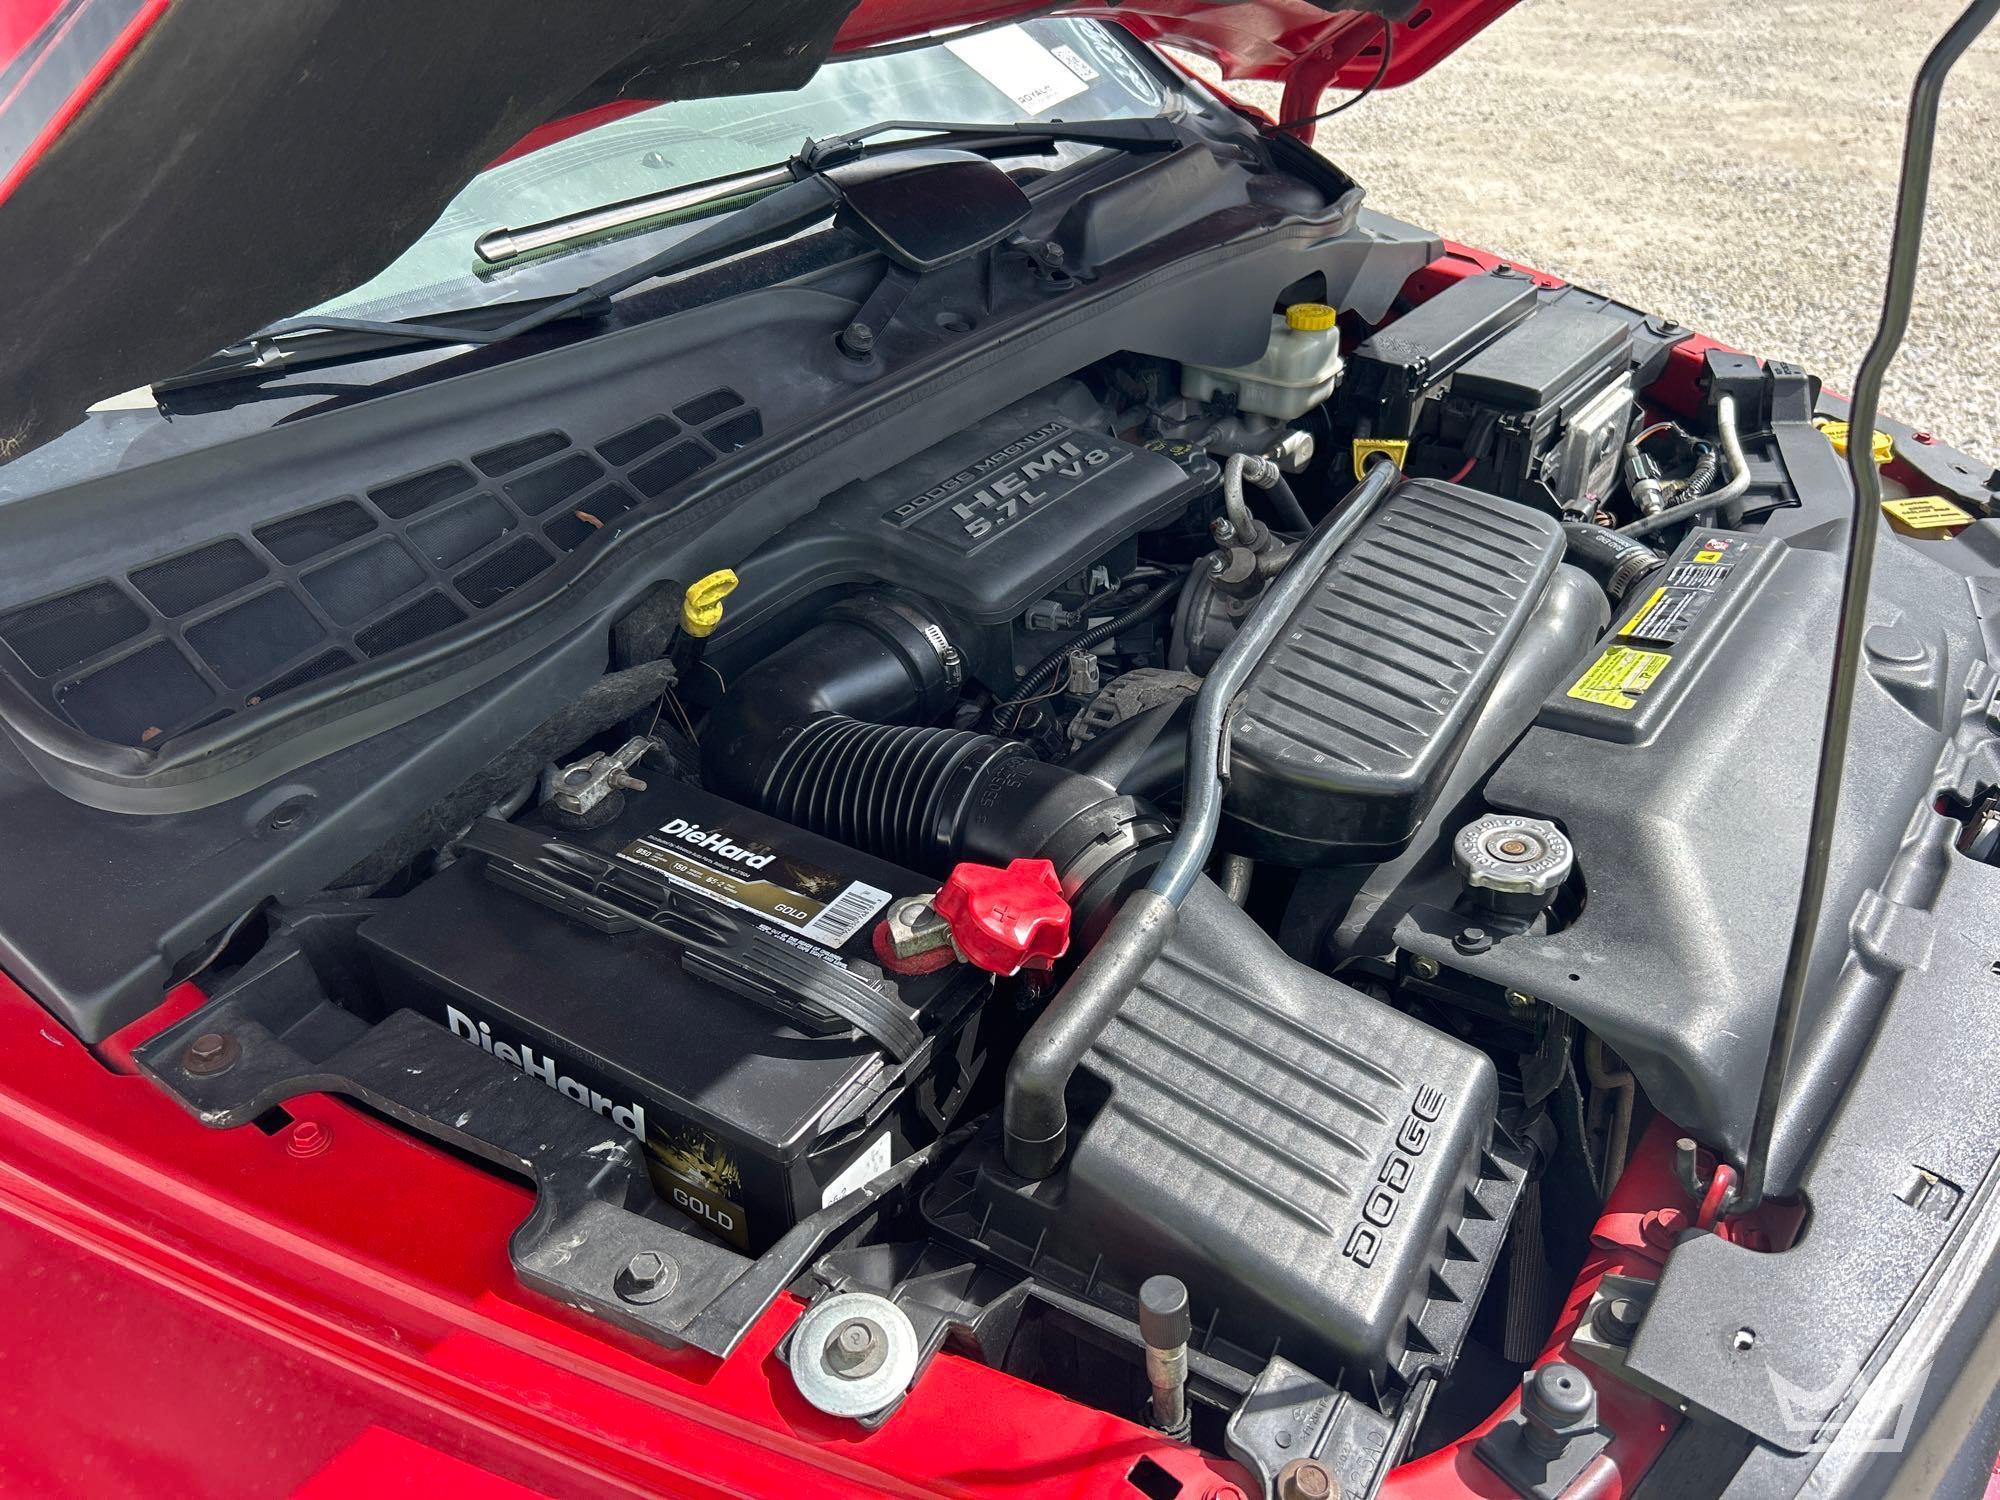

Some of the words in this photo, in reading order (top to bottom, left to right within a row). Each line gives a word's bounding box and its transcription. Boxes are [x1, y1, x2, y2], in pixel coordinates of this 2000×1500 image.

[894, 470, 975, 518] DODGE
[975, 421, 1066, 472] MAGNUM
[951, 441, 1083, 521] HEMI
[963, 490, 1048, 538] 5.7L
[1057, 448, 1112, 479] V8
[659, 818, 777, 871] DieHard
[672, 862, 688, 873] 150
[774, 903, 808, 920] GOLD
[446, 1004, 646, 1143] DieHard
[672, 1186, 734, 1233] GOLD
[1342, 1083, 1447, 1269] DODGE
